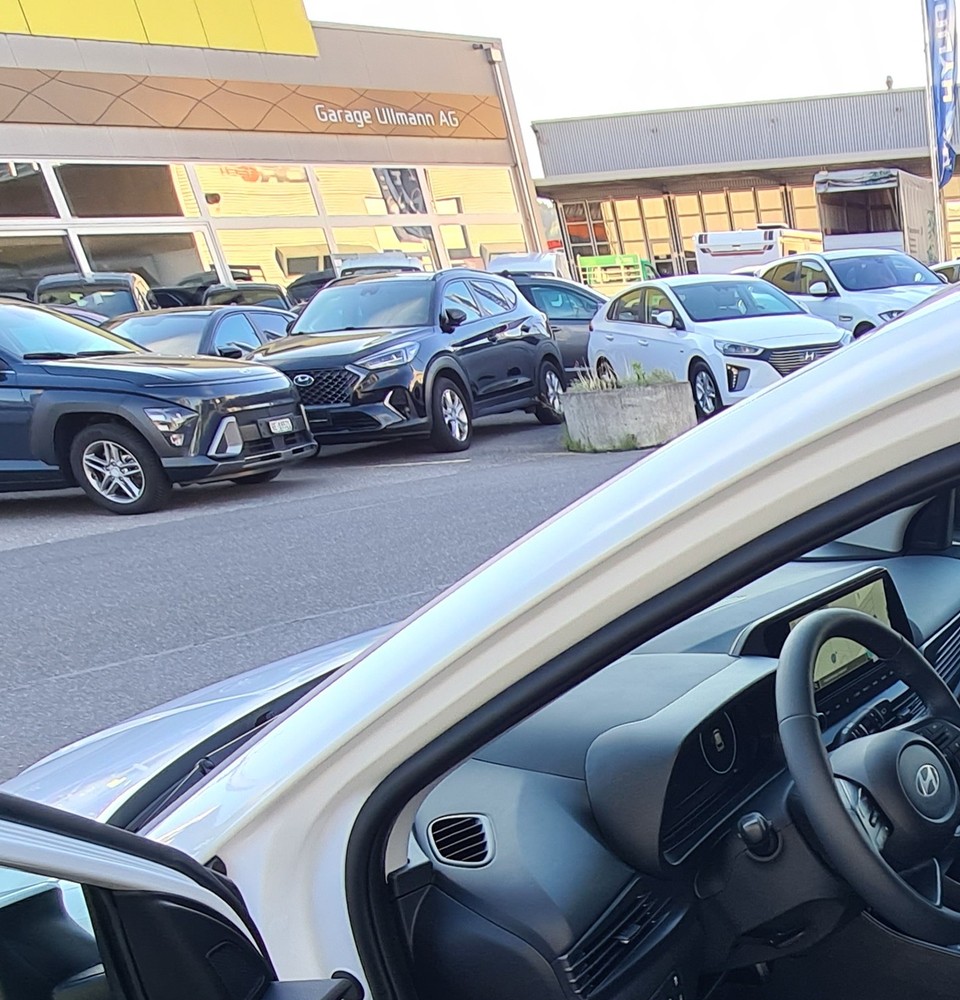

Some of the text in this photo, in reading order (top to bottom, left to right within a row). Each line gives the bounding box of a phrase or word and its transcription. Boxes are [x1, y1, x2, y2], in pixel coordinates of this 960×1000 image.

[314, 104, 459, 128] Garage Ullmann AG
